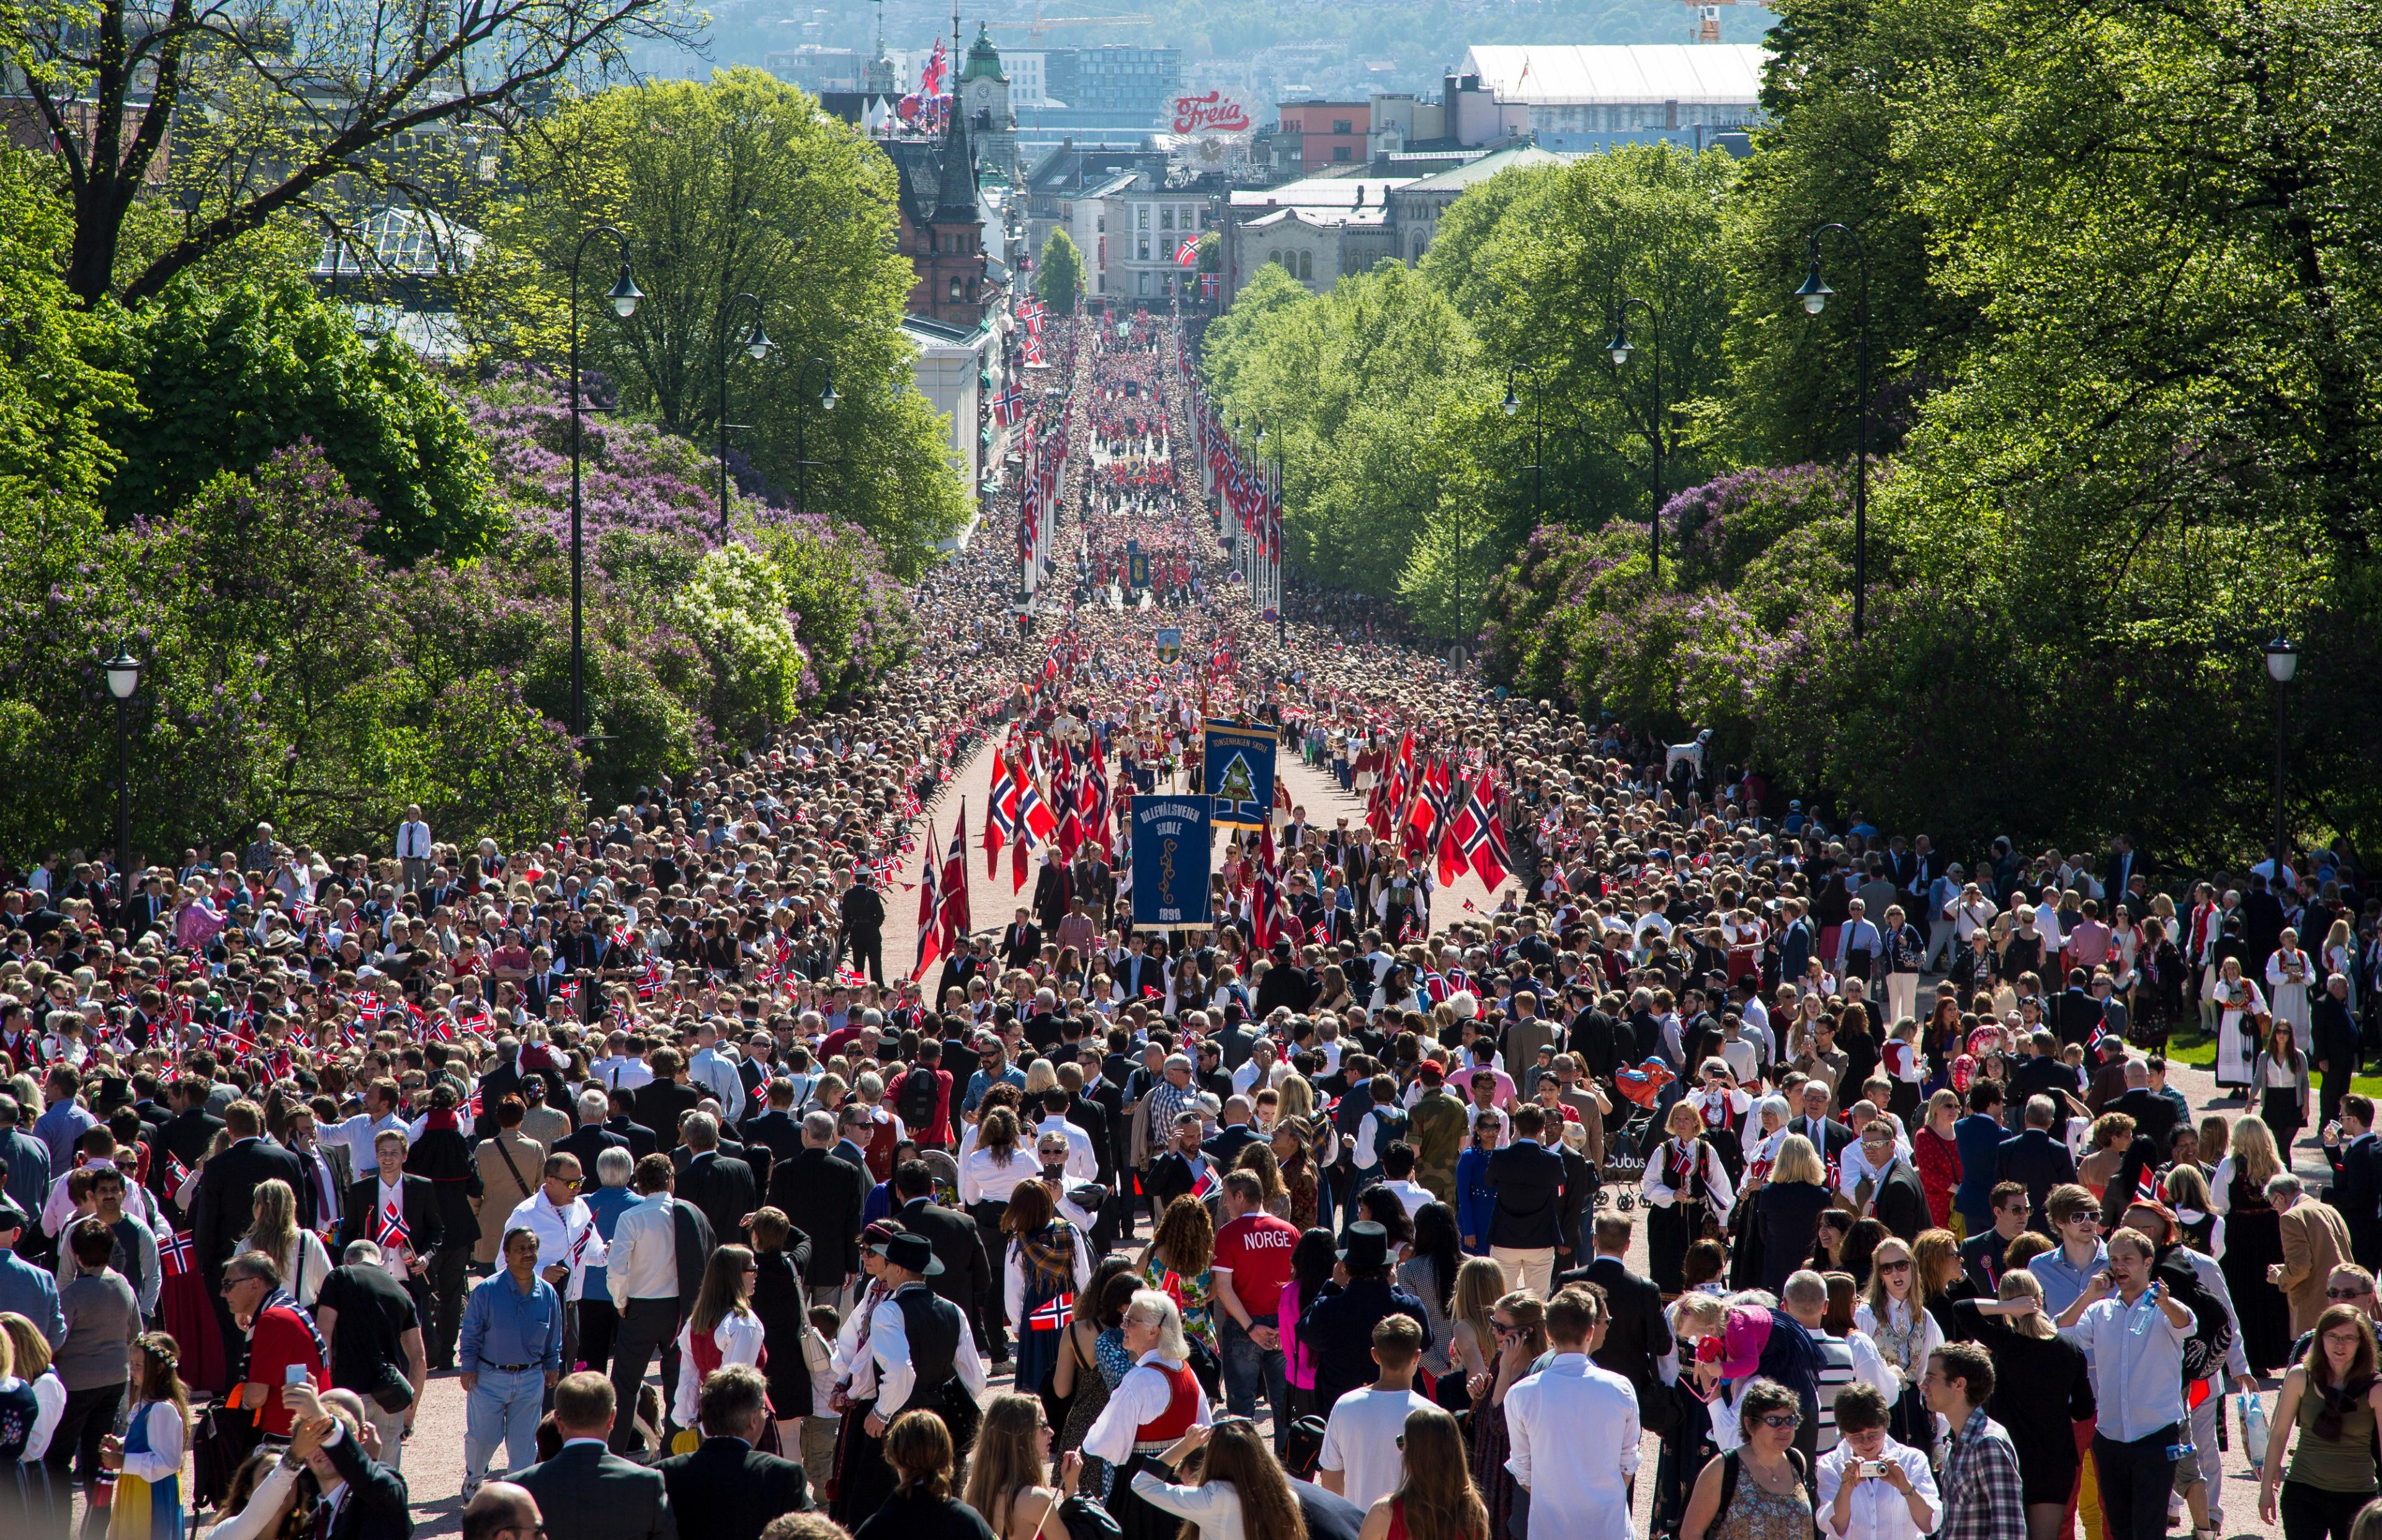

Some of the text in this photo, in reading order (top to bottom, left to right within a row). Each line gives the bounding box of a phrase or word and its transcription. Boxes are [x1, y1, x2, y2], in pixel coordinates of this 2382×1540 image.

[1173, 91, 1250, 134] Freia
[1212, 737, 1269, 754] TONSENHAGEN SKOLE
[1140, 801, 1200, 824] ULLEVÅLSVEIEN
[1156, 821, 1182, 835] SKOLE
[1159, 907, 1181, 921] 1898
[1605, 1152, 1646, 1168] Cubus
[1243, 1231, 1291, 1250] NORGE
